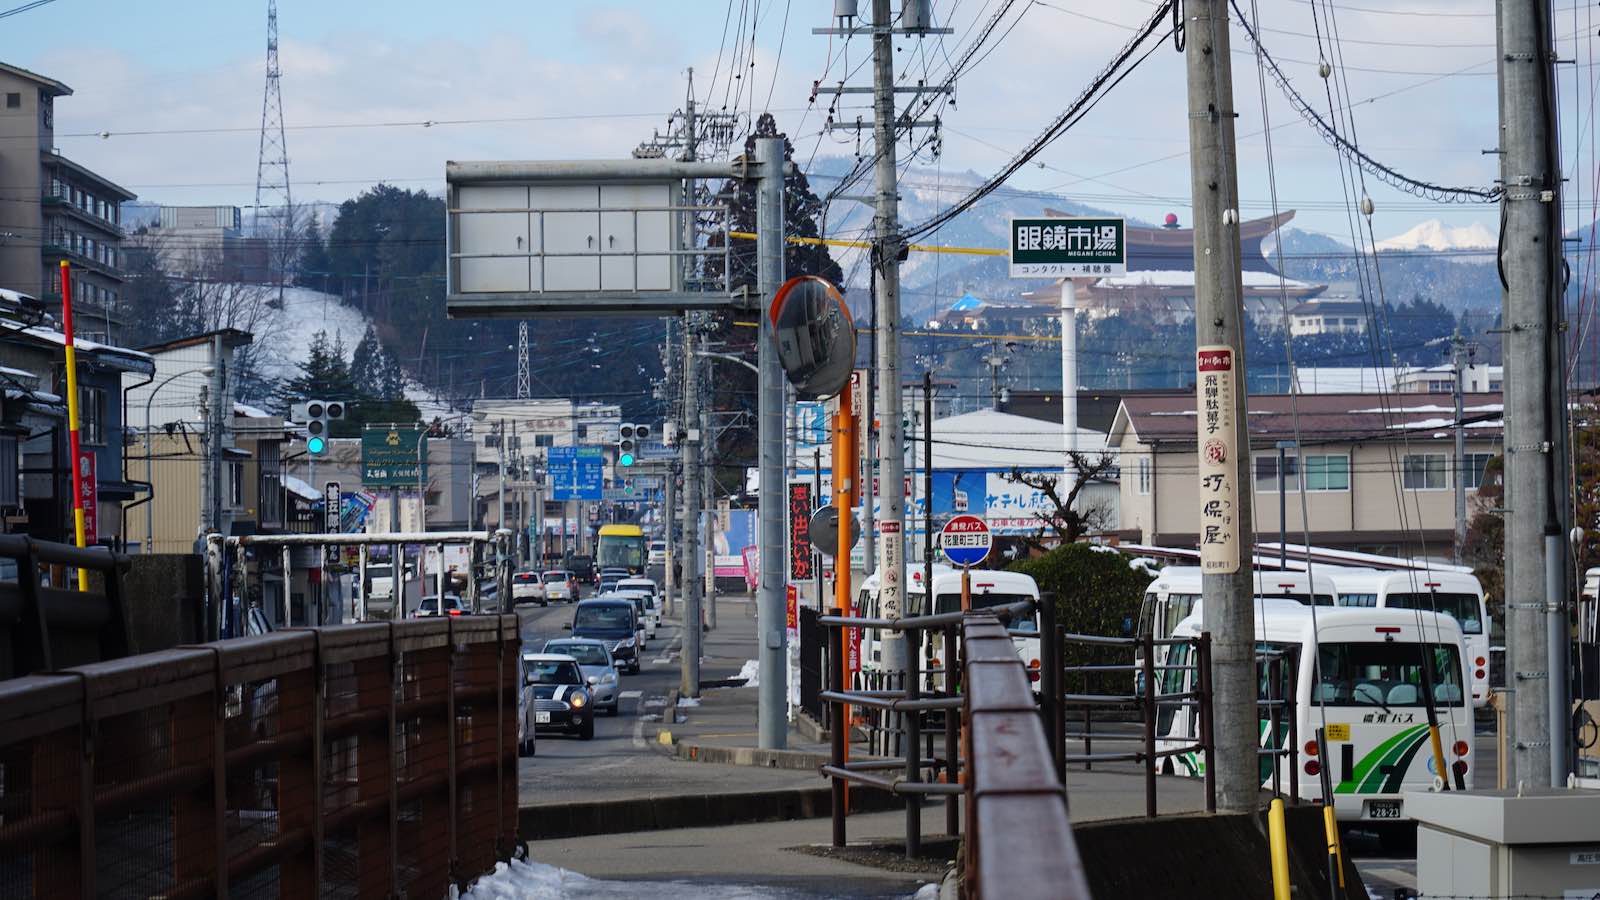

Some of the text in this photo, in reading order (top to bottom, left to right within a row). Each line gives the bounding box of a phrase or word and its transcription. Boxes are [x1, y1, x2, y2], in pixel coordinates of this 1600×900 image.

[1018, 225, 1116, 250] 眼鏡市場
[944, 534, 989, 546] 花里町三丁目
[1376, 808, 1399, 817] 28-23
[1577, 854, 1600, 862] 高圧
